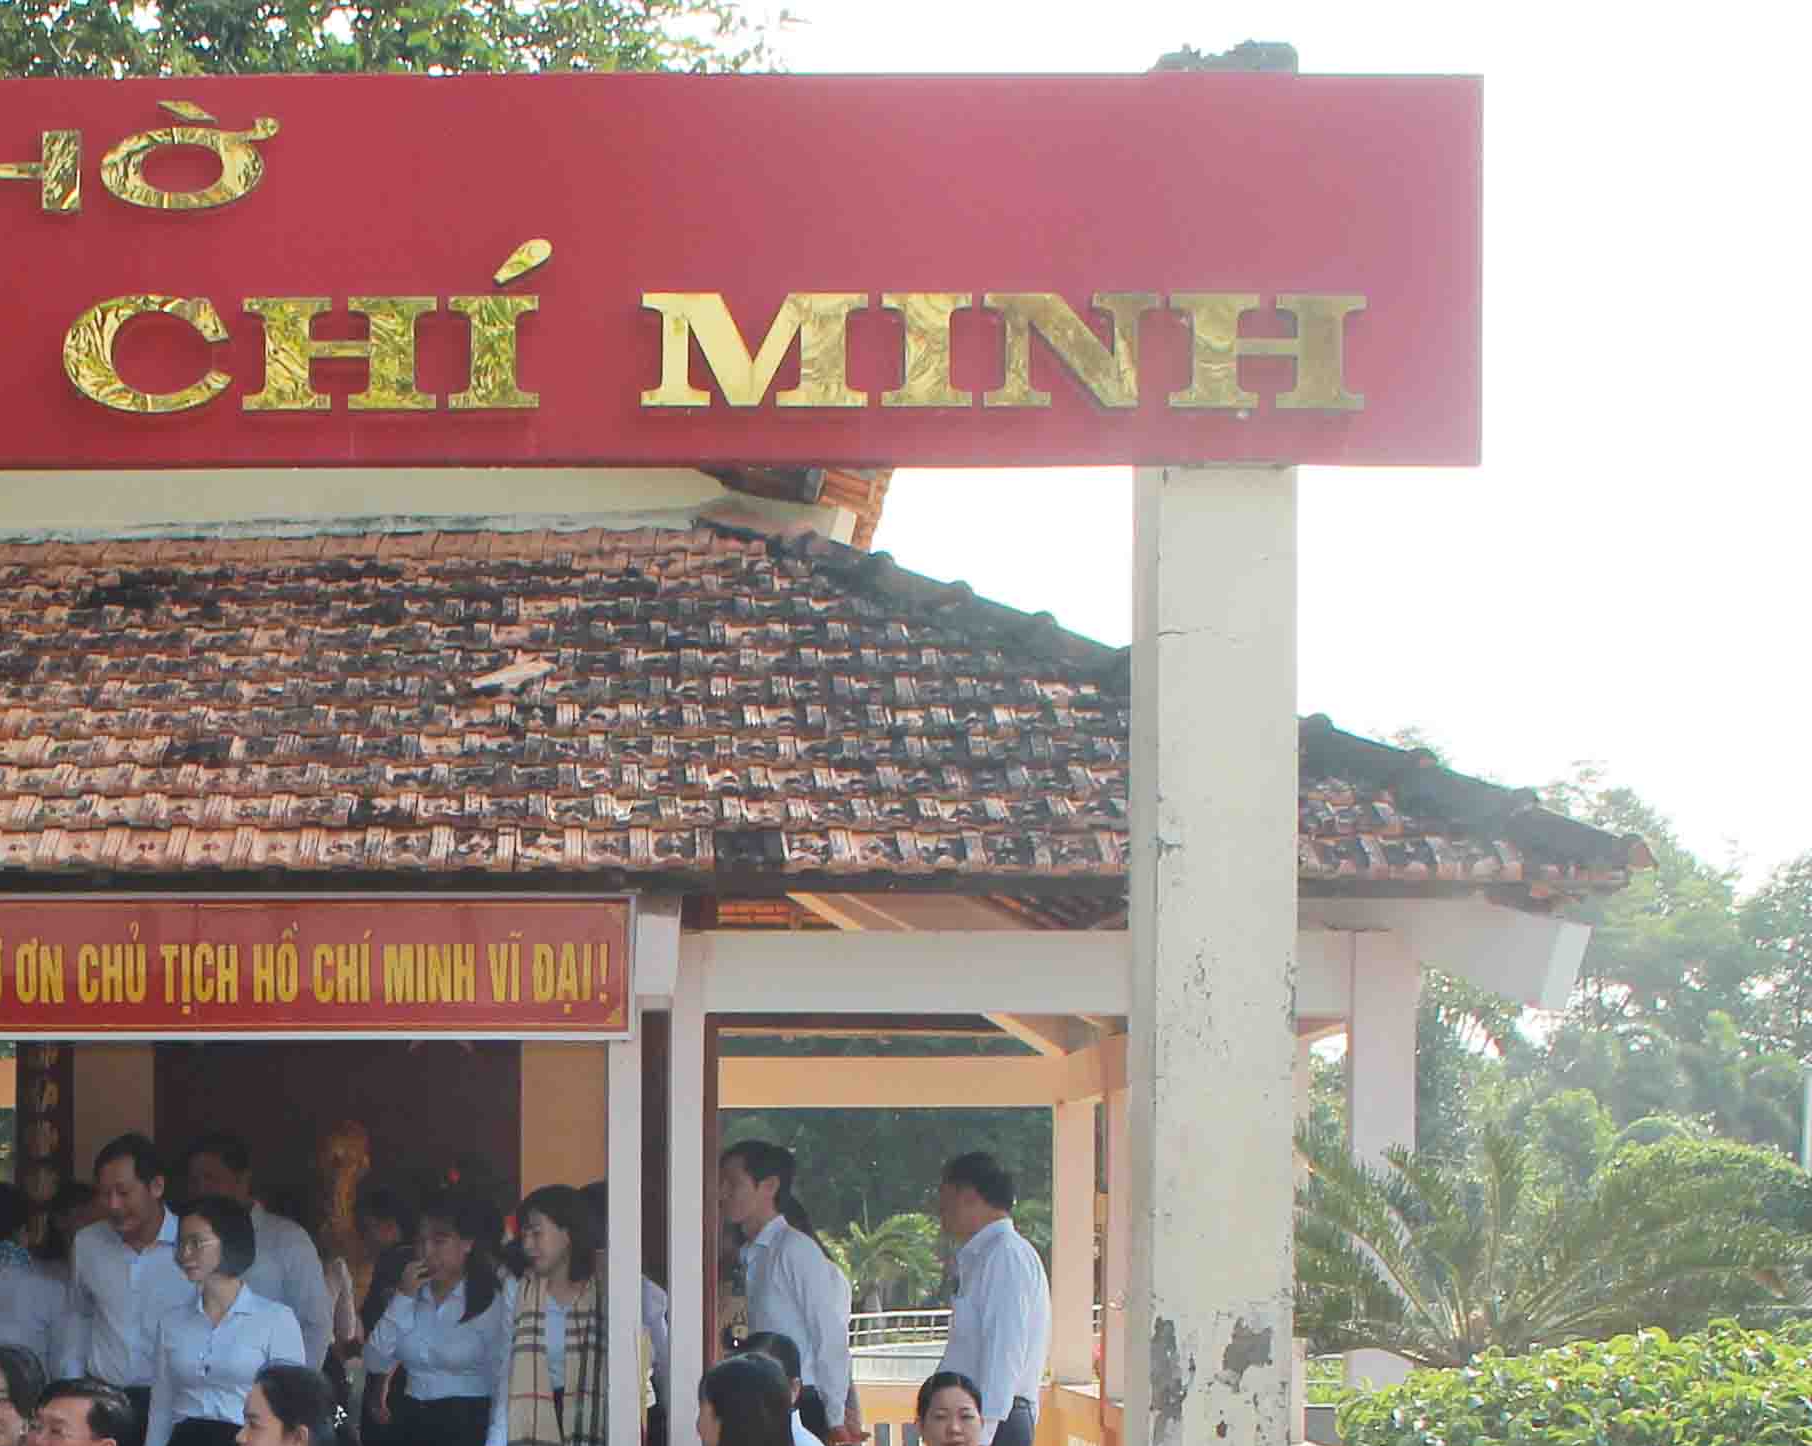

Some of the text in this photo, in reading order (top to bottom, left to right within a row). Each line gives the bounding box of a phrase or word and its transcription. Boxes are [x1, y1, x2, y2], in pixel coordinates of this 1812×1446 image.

[62, 237, 552, 414] CHÍ
[638, 291, 1368, 413] MINH
[14, 936, 65, 1004] ƠN
[77, 920, 148, 1004] CHỦ
[160, 942, 239, 1015] TỊCH
[252, 920, 301, 1003] HỒ
[312, 928, 373, 1003] CHÍ
[383, 943, 475, 1003] MINH
[488, 930, 524, 1002] VĨ
